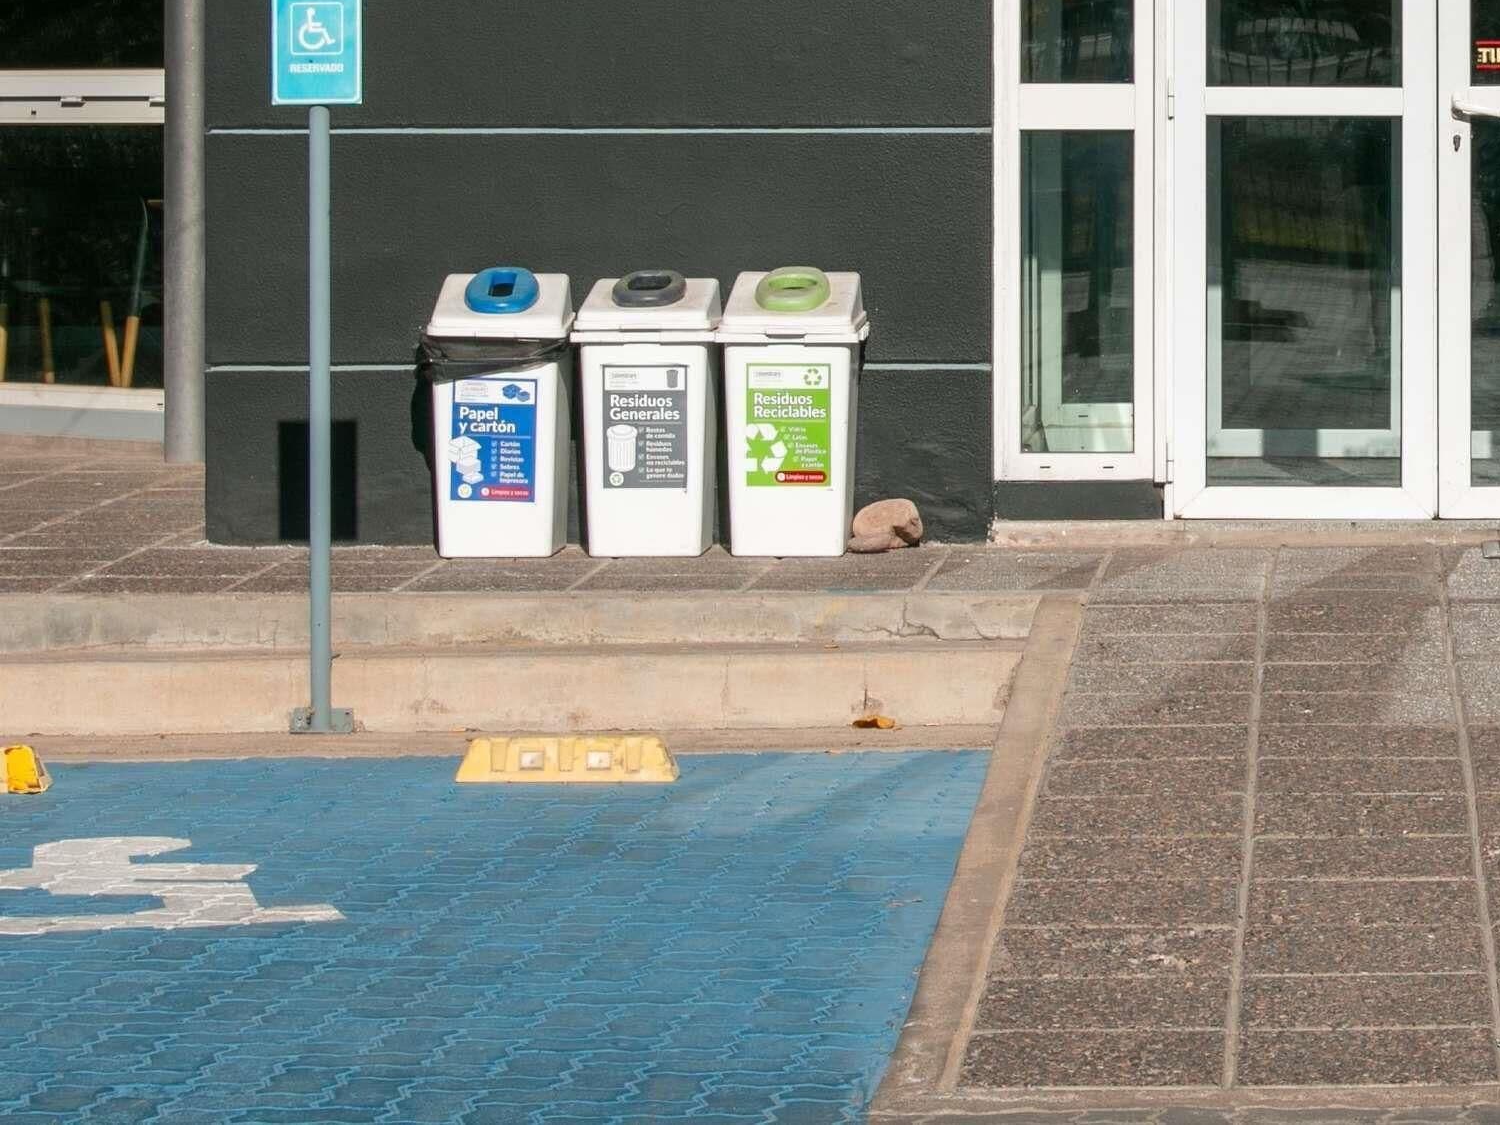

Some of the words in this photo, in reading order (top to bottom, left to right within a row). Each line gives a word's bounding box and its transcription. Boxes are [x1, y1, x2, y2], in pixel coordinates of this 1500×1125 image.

[289, 62, 344, 73] RESERVADO
[610, 394, 673, 407] Residuos
[754, 392, 813, 405] Residuos
[459, 406, 499, 422] Papel
[609, 407, 681, 420] Generales
[754, 405, 827, 418] Reciclables
[459, 422, 468, 434] y
[470, 420, 516, 433] cartón
